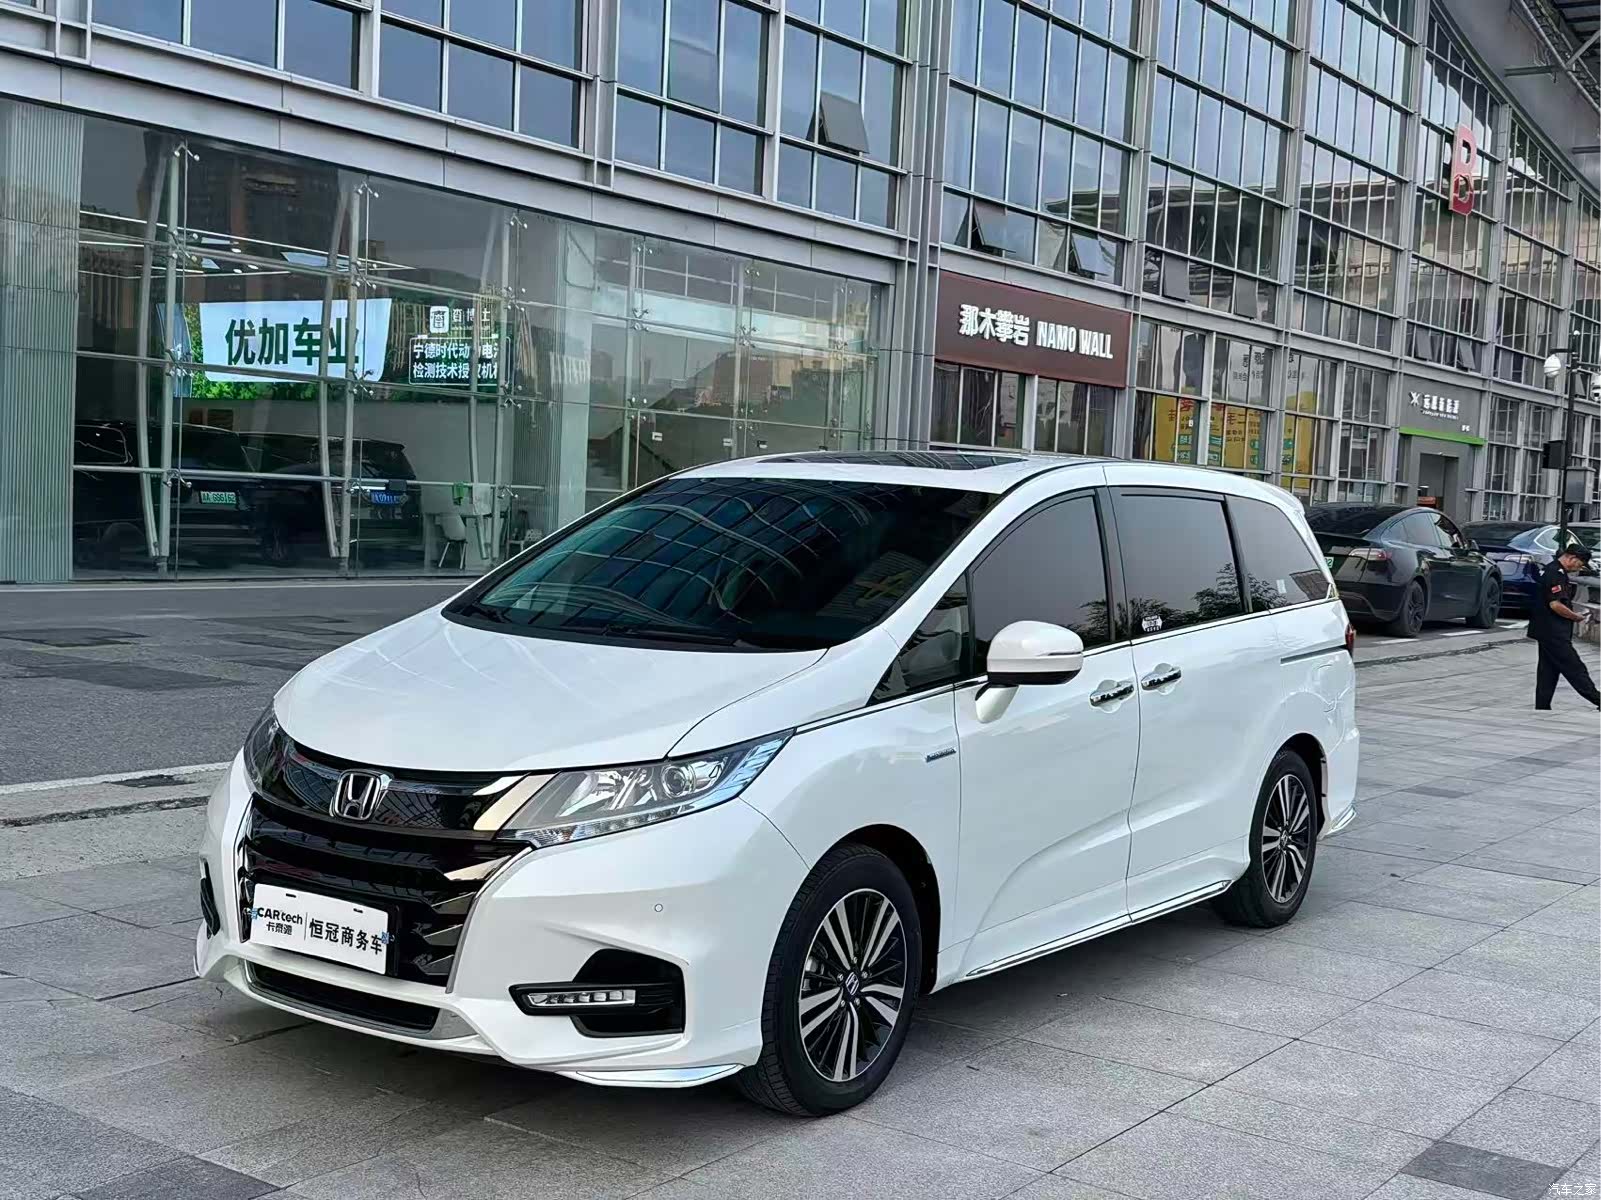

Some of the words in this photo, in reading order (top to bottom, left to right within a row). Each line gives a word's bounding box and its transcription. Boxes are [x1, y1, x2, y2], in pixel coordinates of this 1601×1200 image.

[225, 316, 359, 367] 优加车业
[958, 303, 1030, 347] 那木攀岩
[1036, 320, 1077, 353] NAMO
[1078, 328, 1114, 360] WALL
[413, 341, 499, 359] 宁德时代动电
[412, 361, 498, 379] 检测技术授机
[256, 906, 304, 926] CARtech
[308, 917, 383, 956] 恒冠商务车
